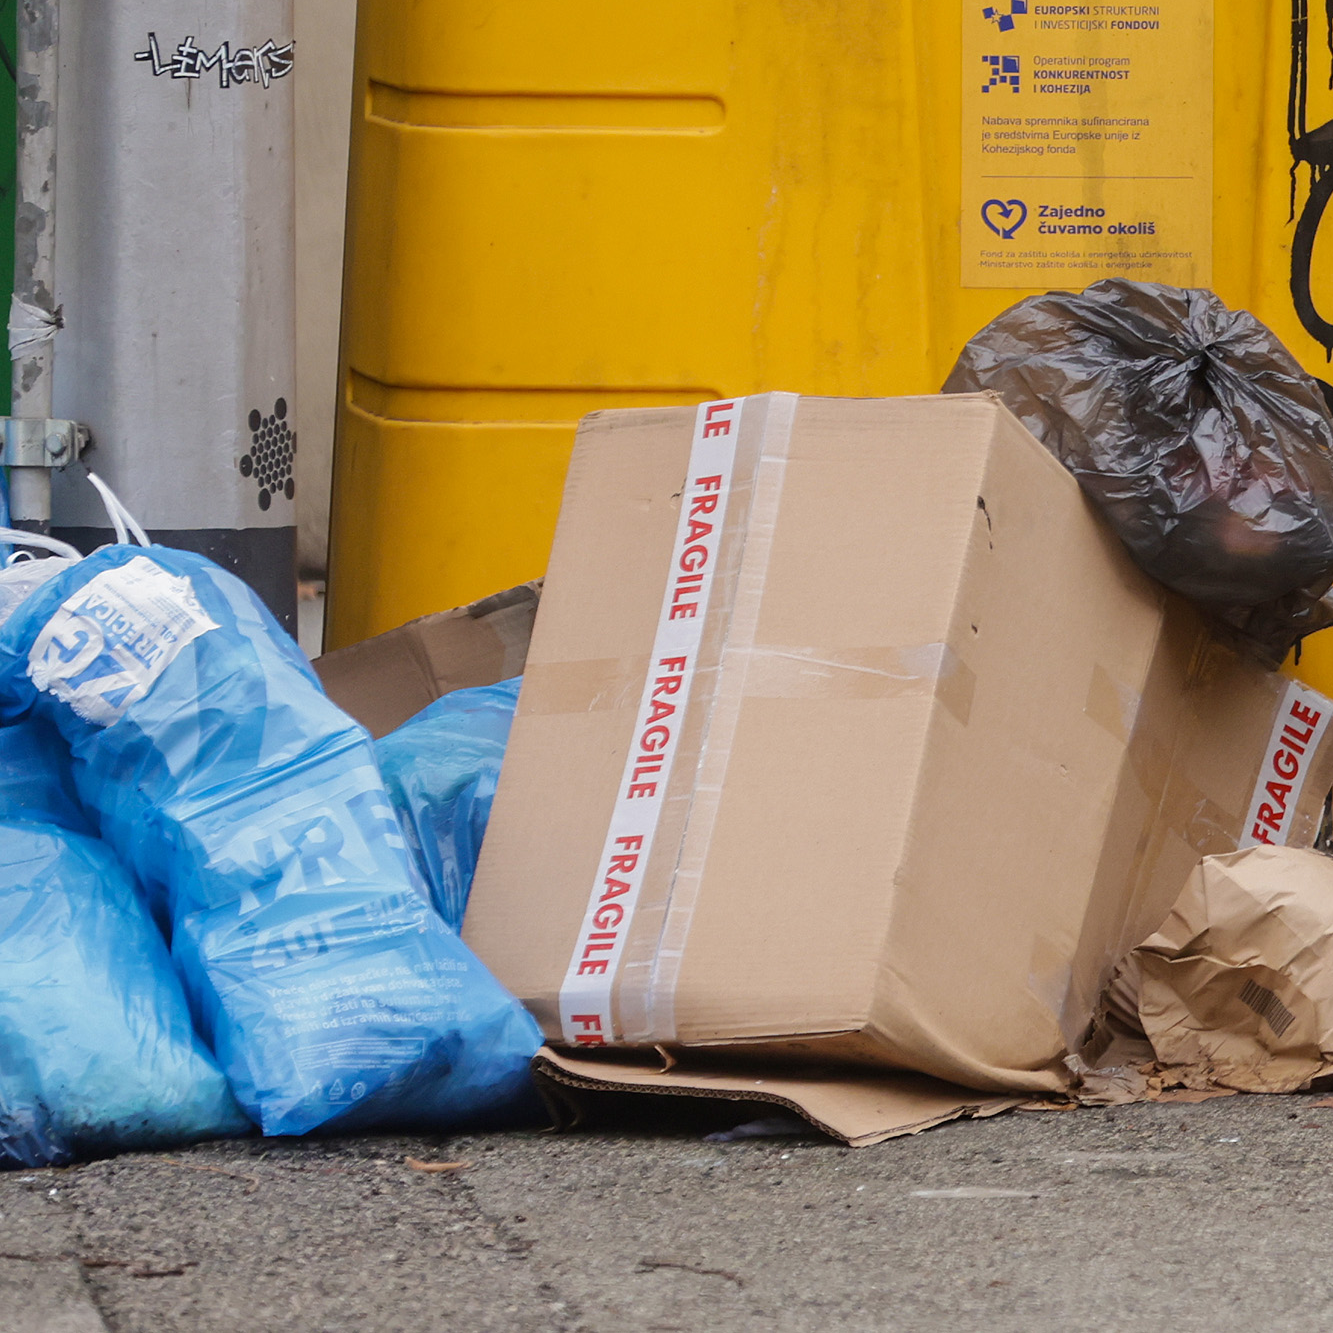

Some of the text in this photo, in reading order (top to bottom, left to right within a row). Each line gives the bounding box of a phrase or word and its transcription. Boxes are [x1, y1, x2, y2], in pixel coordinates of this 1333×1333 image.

[1034, 6, 1160, 16] EUROPSKI STRUKTURNI
[1040, 20, 1108, 31] INVESTICIJSKI
[1111, 21, 1160, 30] FONDOVI
[1033, 56, 1130, 66] Operativni program
[1033, 70, 1130, 79] KONKURENTNOST
[1040, 84, 1091, 95] KOHEZIJA
[982, 116, 1150, 128] Nabava spremnika sufinancirana
[981, 130, 1140, 142] je sredstvima Europske unije iz
[981, 144, 1076, 156] Kohezijskog fonda
[1038, 205, 1105, 219] Zajedno
[1038, 222, 1155, 235] čuvamo okoliš
[668, 474, 723, 624] FRAGILE
[86, 593, 165, 666] VREĆICA
[626, 655, 689, 801] FRAGILE
[1250, 699, 1322, 846] FRAGILE
[575, 833, 644, 977] FRAGILE
